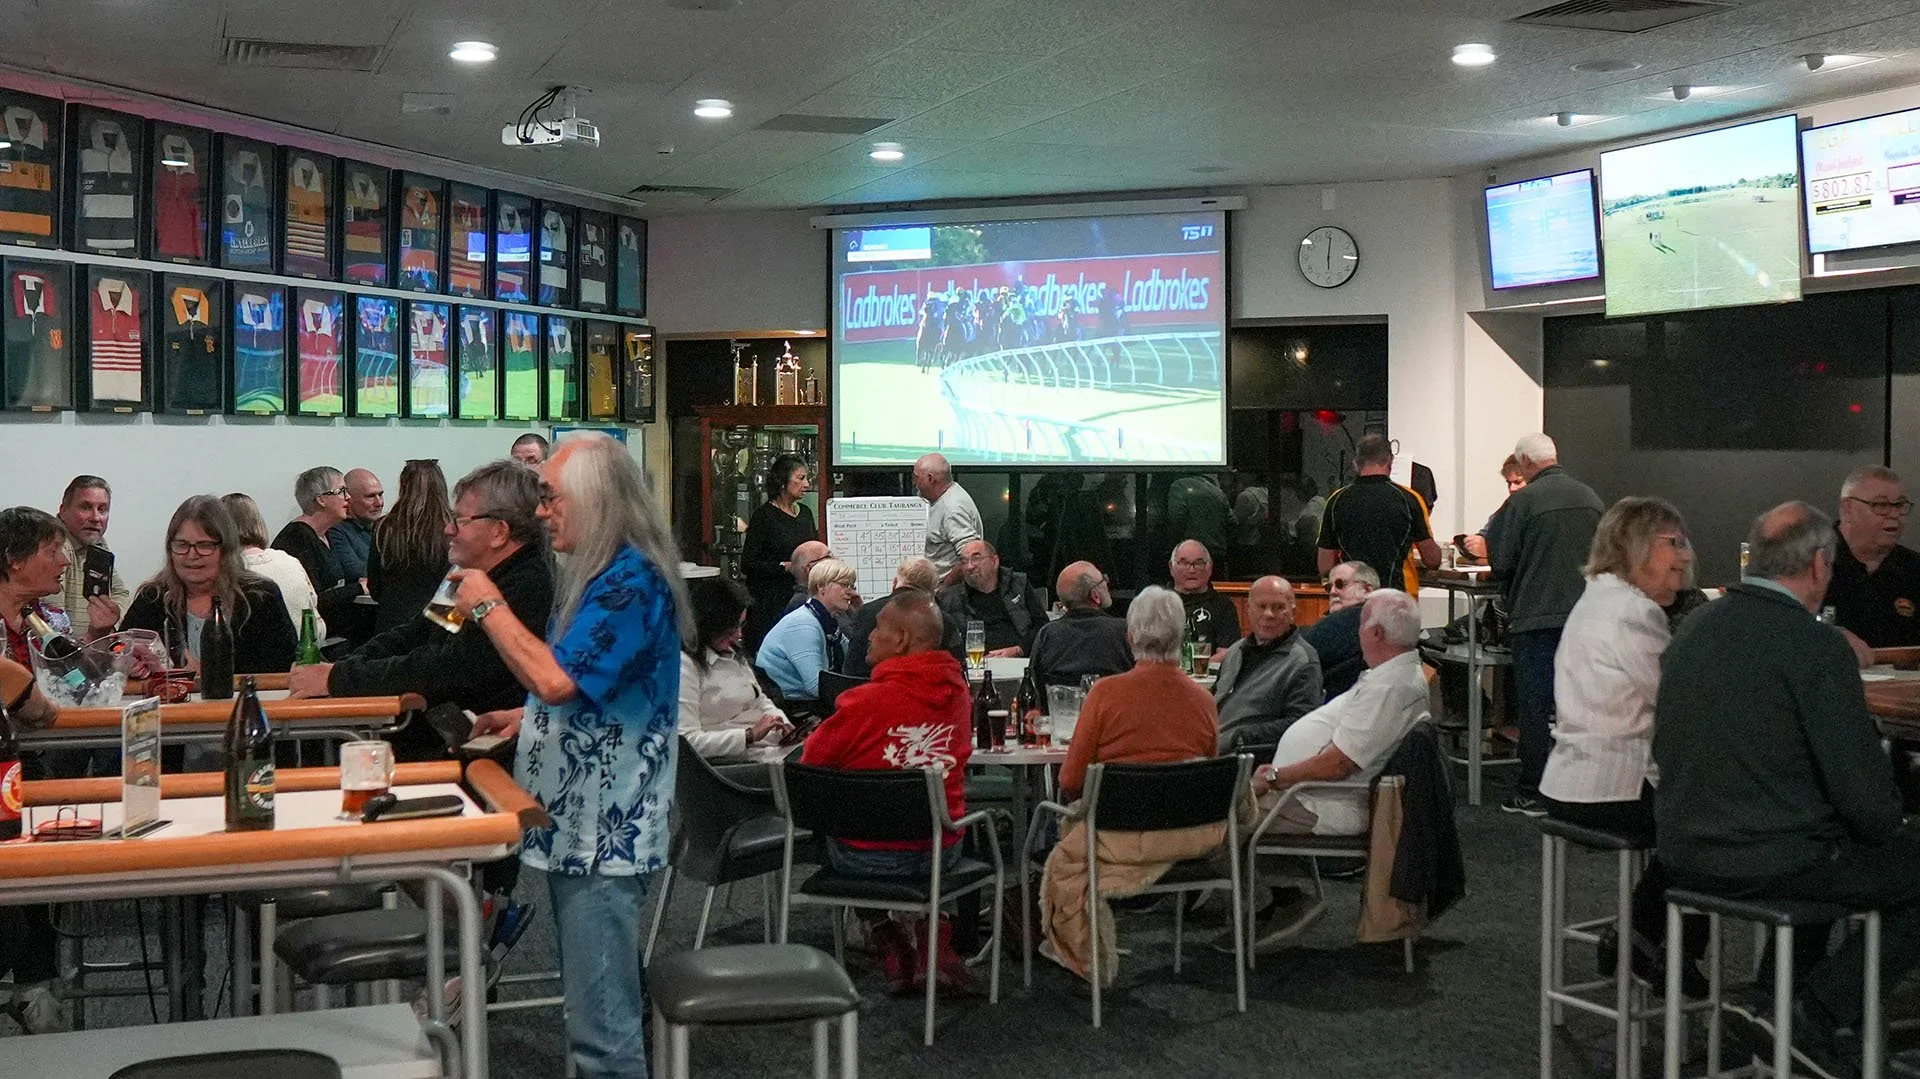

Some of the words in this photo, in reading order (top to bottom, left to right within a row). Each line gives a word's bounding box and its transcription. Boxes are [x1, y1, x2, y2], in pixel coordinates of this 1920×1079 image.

[846, 284, 917, 329] Ladbrokes
[1018, 272, 1106, 317] adbrokes
[1123, 268, 1210, 313] Ladbrokes
